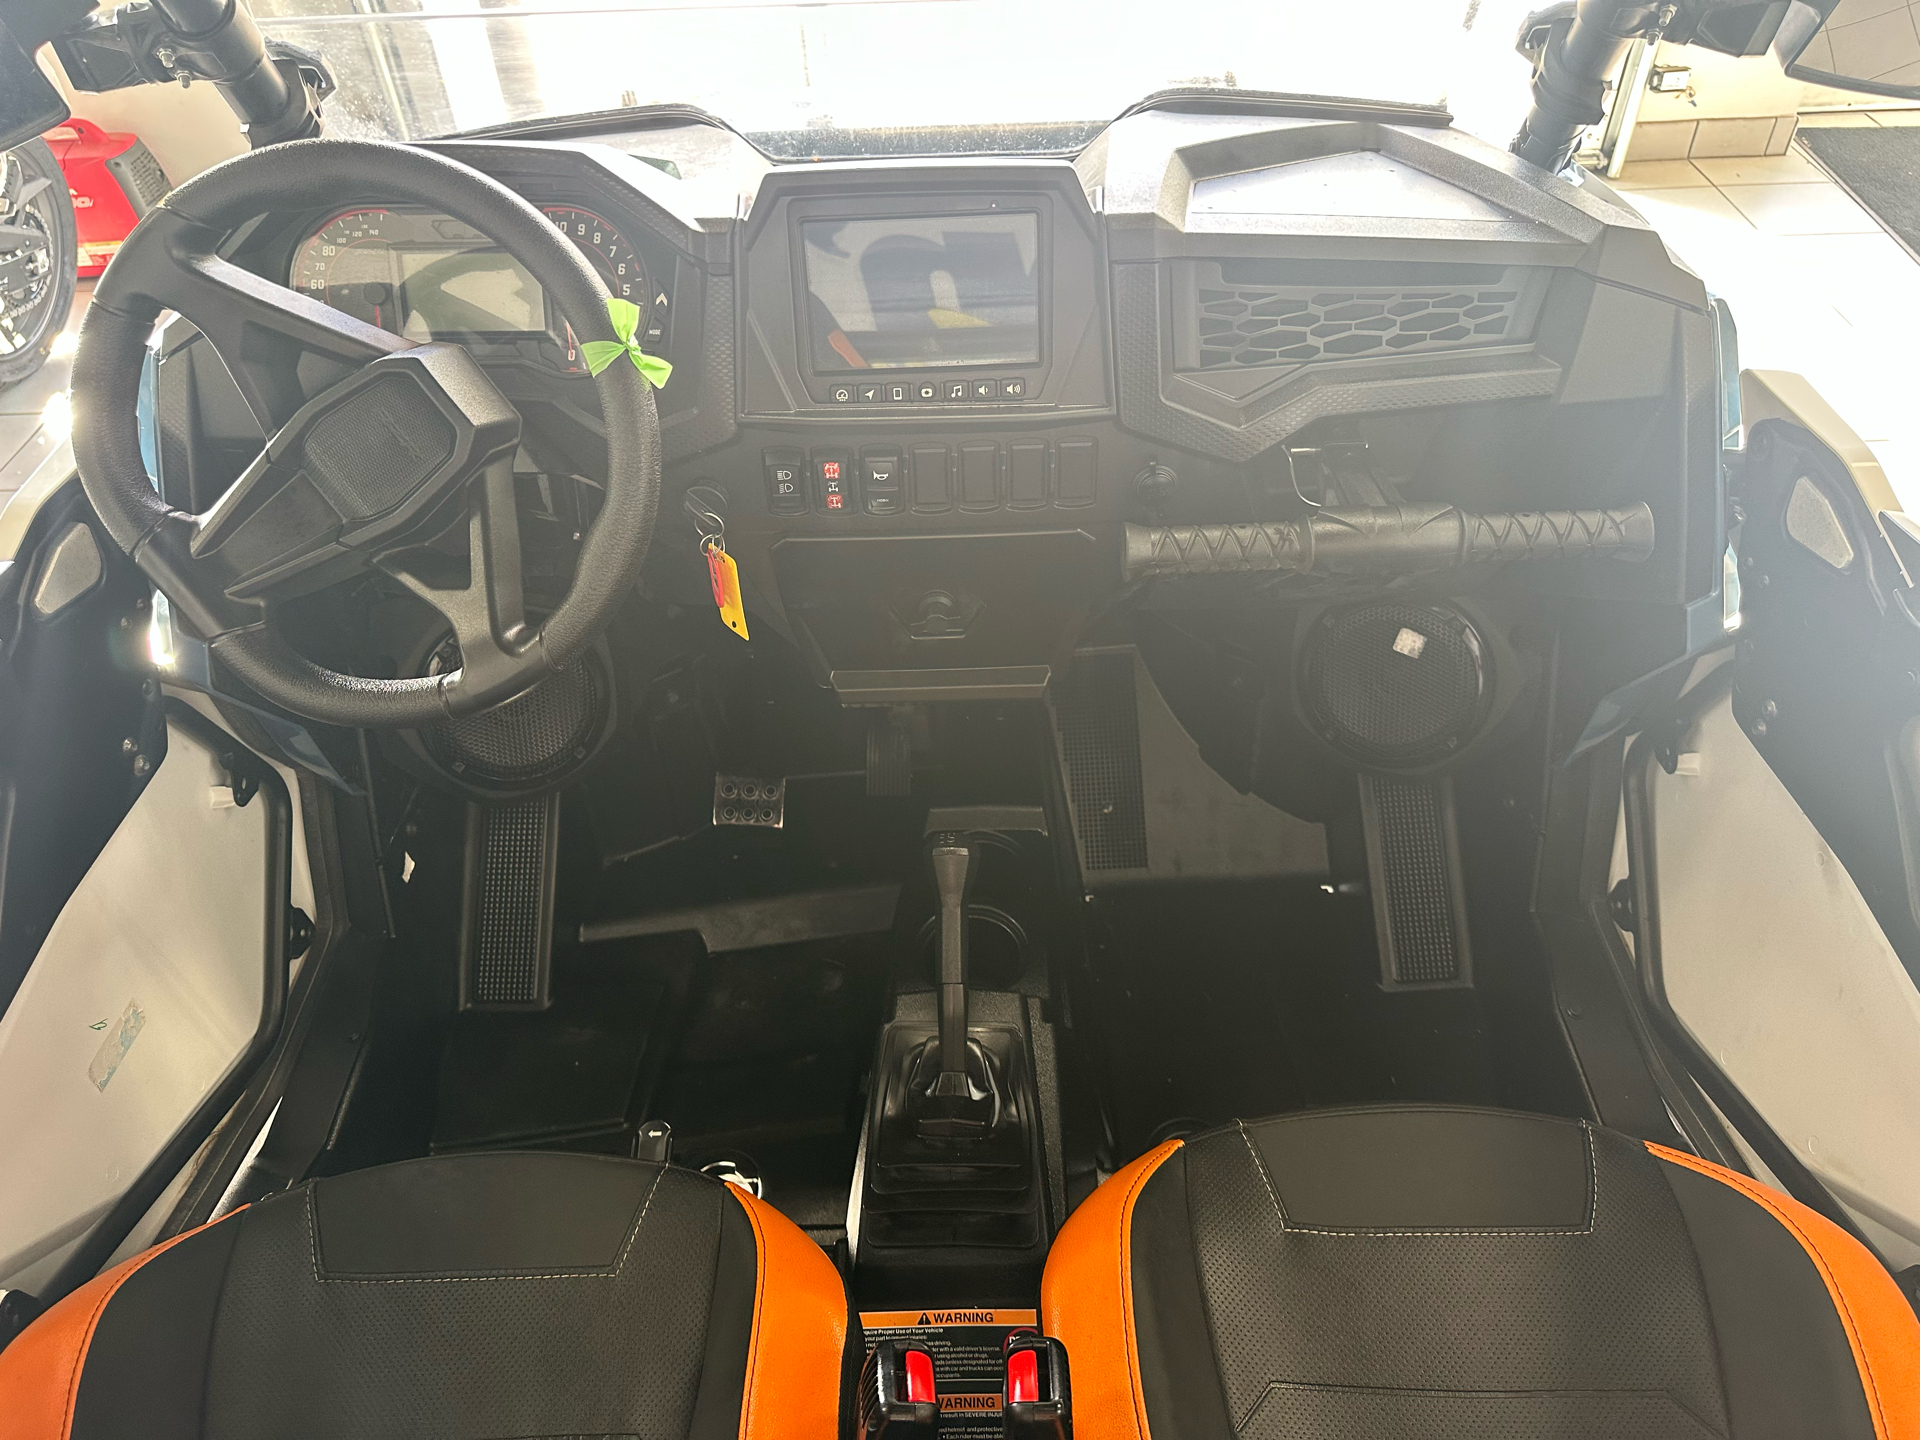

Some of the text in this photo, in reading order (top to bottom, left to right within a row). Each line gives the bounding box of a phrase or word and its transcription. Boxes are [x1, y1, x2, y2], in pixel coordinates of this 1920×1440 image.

[577, 223, 586, 236] 9
[593, 232, 602, 244] 8
[322, 246, 335, 256] 80
[609, 245, 617, 258] 7
[315, 263, 325, 271] 70
[617, 263, 626, 275] 6
[310, 279, 324, 289] 60
[622, 284, 631, 296] 5
[648, 328, 661, 336] MODE
[567, 349, 576, 362] 0
[933, 1312, 993, 1323] WARNING
